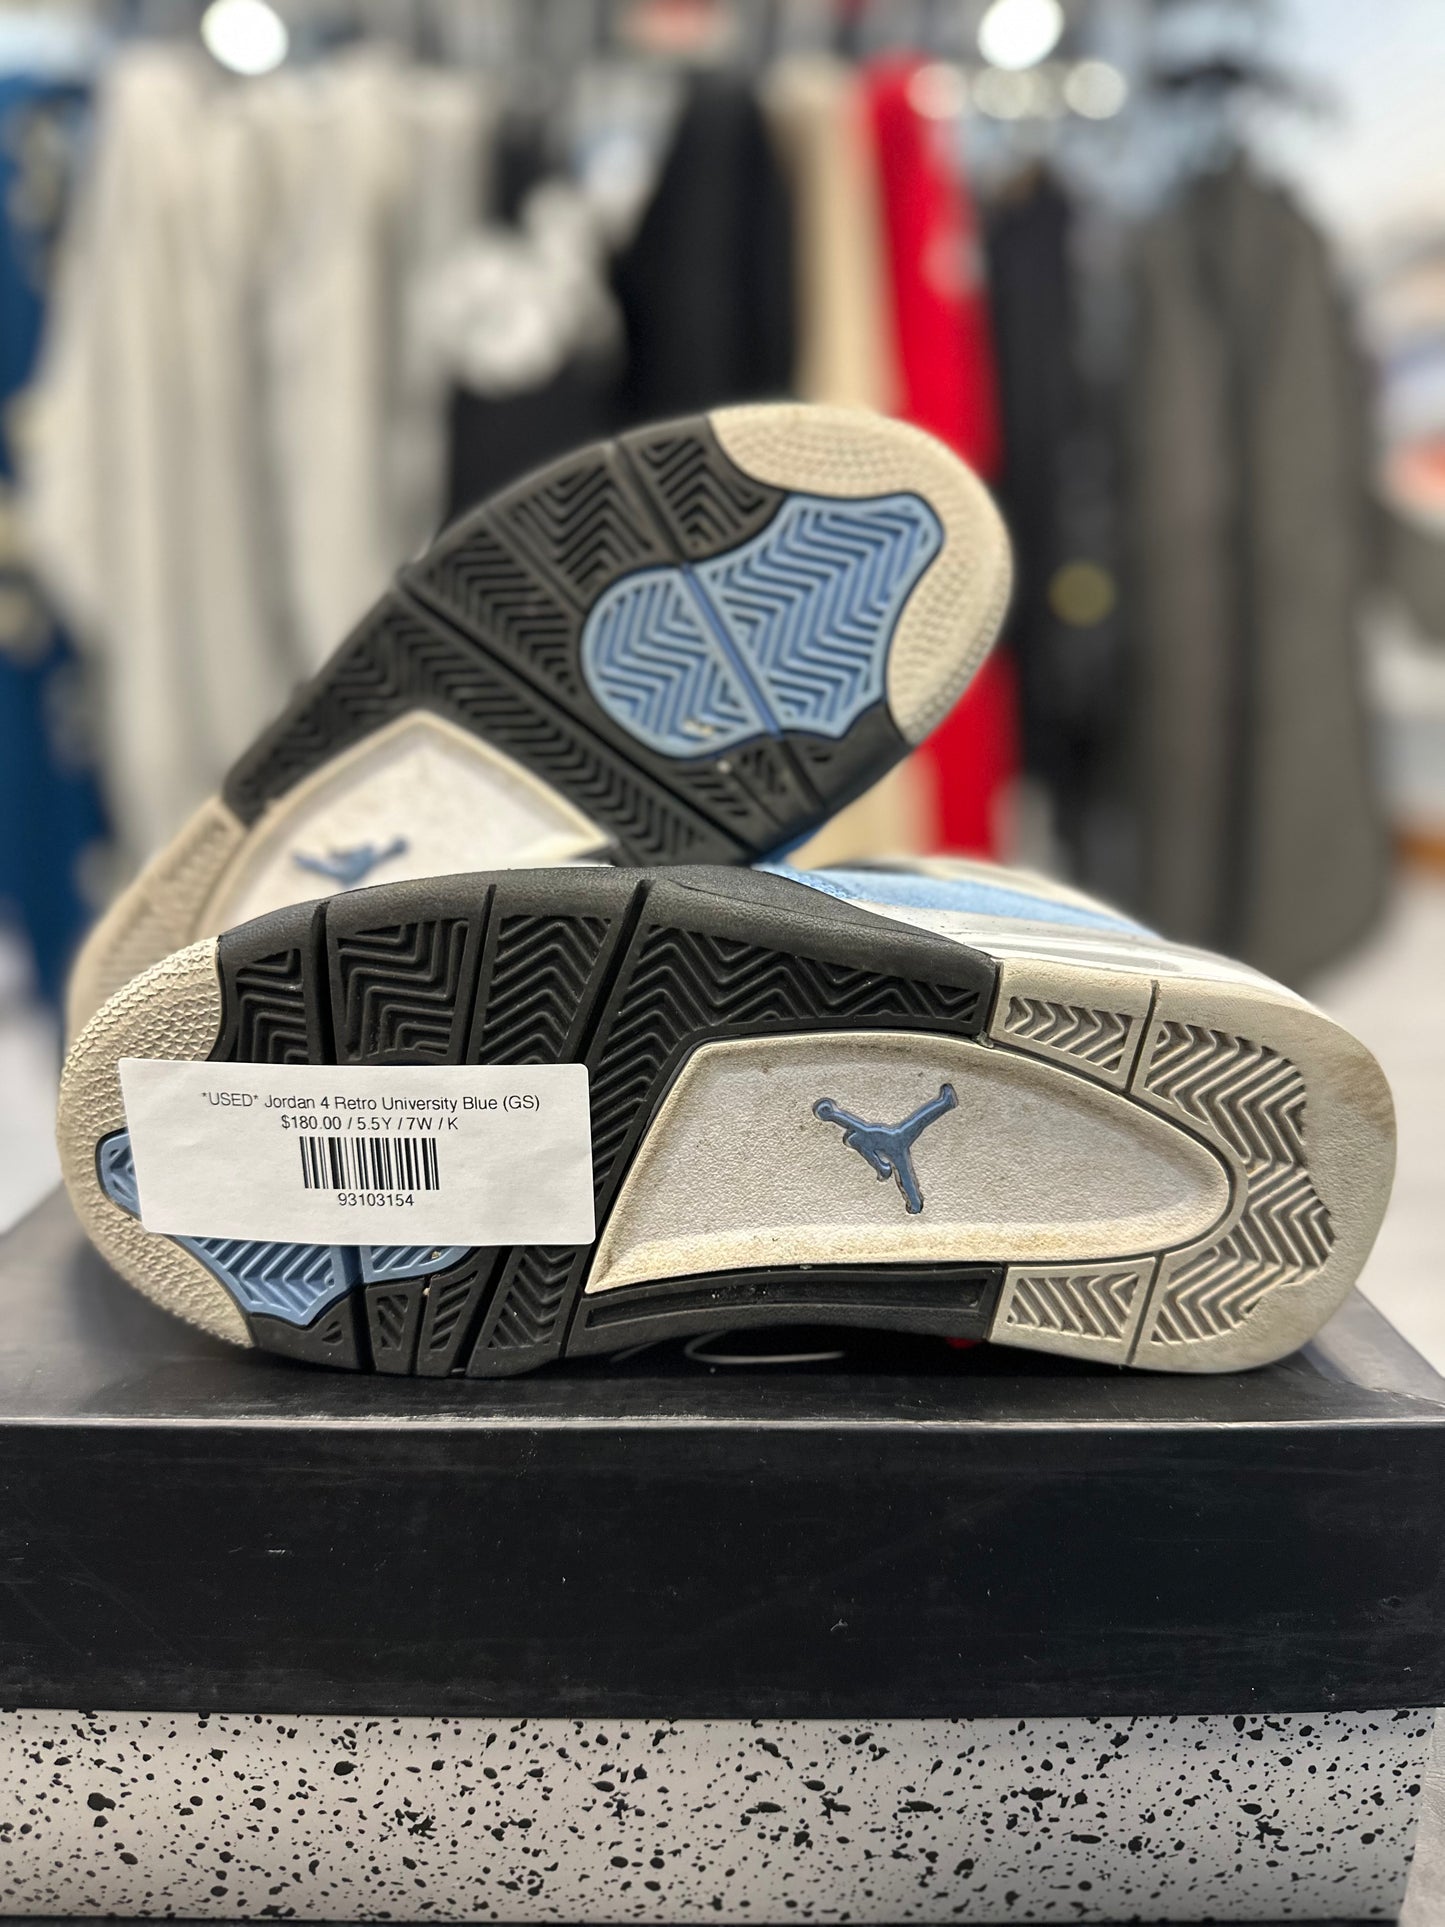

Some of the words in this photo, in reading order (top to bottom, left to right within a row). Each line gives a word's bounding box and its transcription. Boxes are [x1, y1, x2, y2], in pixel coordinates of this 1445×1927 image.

[264, 1094, 316, 1110] Jordan
[320, 1095, 331, 1110] 4
[334, 1096, 378, 1111] Retro
[382, 1096, 458, 1114] University
[463, 1095, 498, 1111] Blue
[503, 1095, 540, 1113] (GS)
[281, 1114, 342, 1131] $180.00
[347, 1116, 353, 1131] /
[357, 1116, 392, 1131] 5.5Y
[397, 1116, 403, 1131] /
[406, 1116, 433, 1131] 7W
[438, 1116, 444, 1131] /
[447, 1116, 459, 1131] K
[338, 1192, 415, 1207] 93103154
